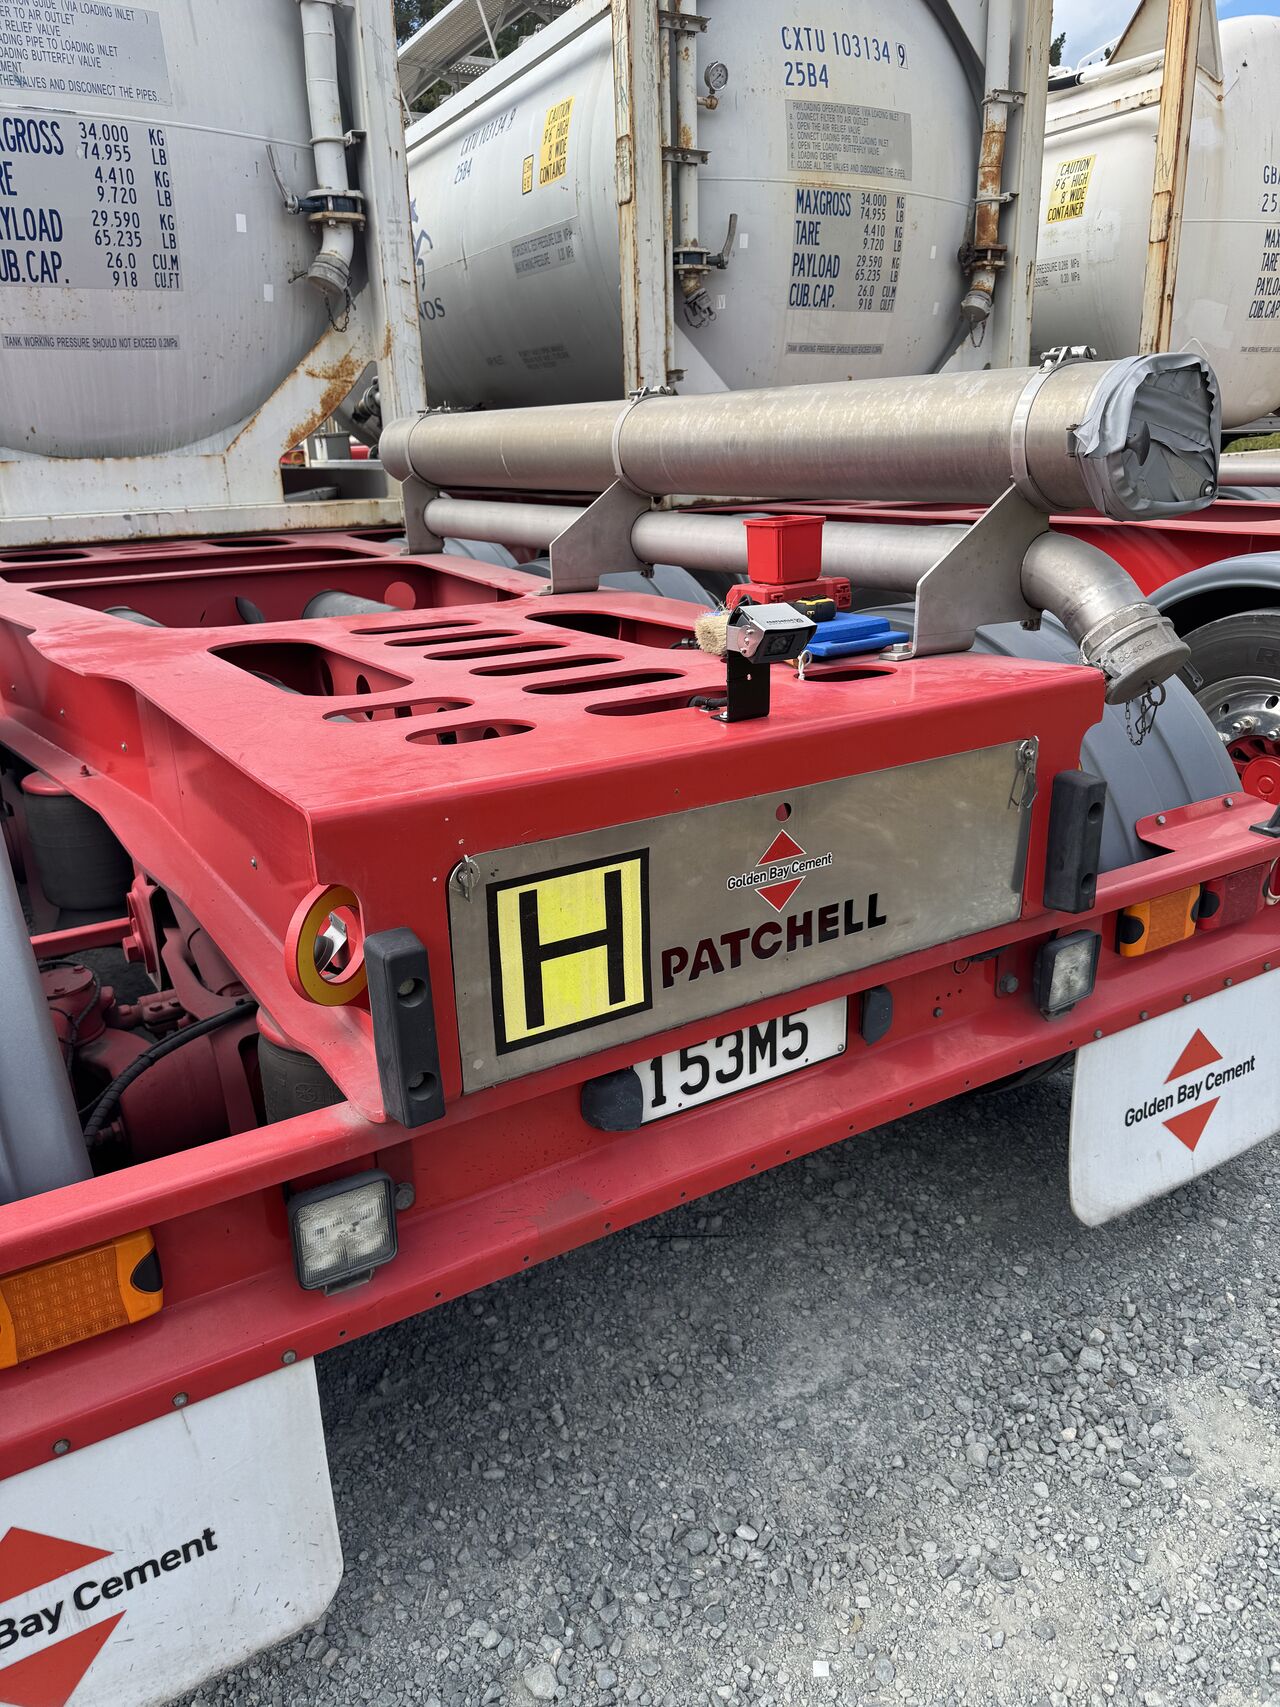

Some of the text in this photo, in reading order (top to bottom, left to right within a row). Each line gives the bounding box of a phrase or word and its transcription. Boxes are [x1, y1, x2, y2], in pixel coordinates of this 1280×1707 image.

[14, 7, 25, 19] TO
[28, 9, 42, 21] AIR
[45, 11, 75, 25] OUTLET
[80, 3, 113, 17] LOADING
[115, 8, 135, 21] INLET
[5, 19, 61, 36] RELIEF VALVE
[26, 35, 44, 48] PIPE
[46, 37, 58, 50] TO
[60, 39, 94, 54] LOADING
[97, 44, 118, 57] INLET
[781, 26, 826, 53] CXTU
[832, 32, 891, 64] 103134
[31, 50, 75, 65] BUTTERFLY
[78, 55, 102, 68] VALVE
[784, 61, 829, 88] 25B4
[50, 79, 65, 91] AND
[68, 80, 116, 97] DISCONNECT
[119, 86, 133, 99] THE
[148, 129, 164, 146] KG
[152, 148, 167, 165] LB
[540, 157, 567, 184] CONTAINER
[1060, 158, 1091, 176] CAUTION
[154, 171, 170, 188] KG
[1071, 172, 1089, 188] HIGH
[157, 190, 172, 207] LB
[796, 188, 852, 217] MAXGROSS
[896, 196, 905, 208] KG
[1069, 187, 1086, 202] WIDE
[896, 210, 904, 223] LB
[1048, 202, 1084, 221] CONTAINER
[0, 207, 63, 242] YLOAD
[159, 214, 175, 231] KG
[796, 220, 821, 246] TARE
[894, 226, 903, 239] KG
[162, 233, 177, 249] LB
[893, 240, 902, 252] LB
[106, 252, 136, 269] 26.0
[153, 254, 179, 271] CU.M
[792, 252, 840, 279] PAYLOAD
[891, 257, 900, 269] KG
[1261, 252, 1280, 271] TARE
[113, 271, 180, 289] 918 CU.FT
[890, 271, 898, 283] LB
[789, 283, 835, 309] CUB.CAP.
[857, 285, 874, 297] 26.0
[858, 298, 872, 310] 918
[1248, 300, 1279, 319] CUB.CAP.
[5, 336, 22, 346] TANK
[24, 336, 54, 348] WORKING
[57, 337, 90, 348] PRESSURE
[92, 338, 117, 348] SHOULD
[119, 338, 131, 348] NOT
[133, 338, 157, 348] EXCEED
[728, 853, 832, 890] Golden Bay Cement
[518, 869, 626, 1030] H
[661, 892, 887, 989] PATCHELL
[650, 1008, 808, 1108] 153M5
[1124, 1055, 1255, 1127] Golden Bay Cement
[73, 1527, 218, 1611] Cement
